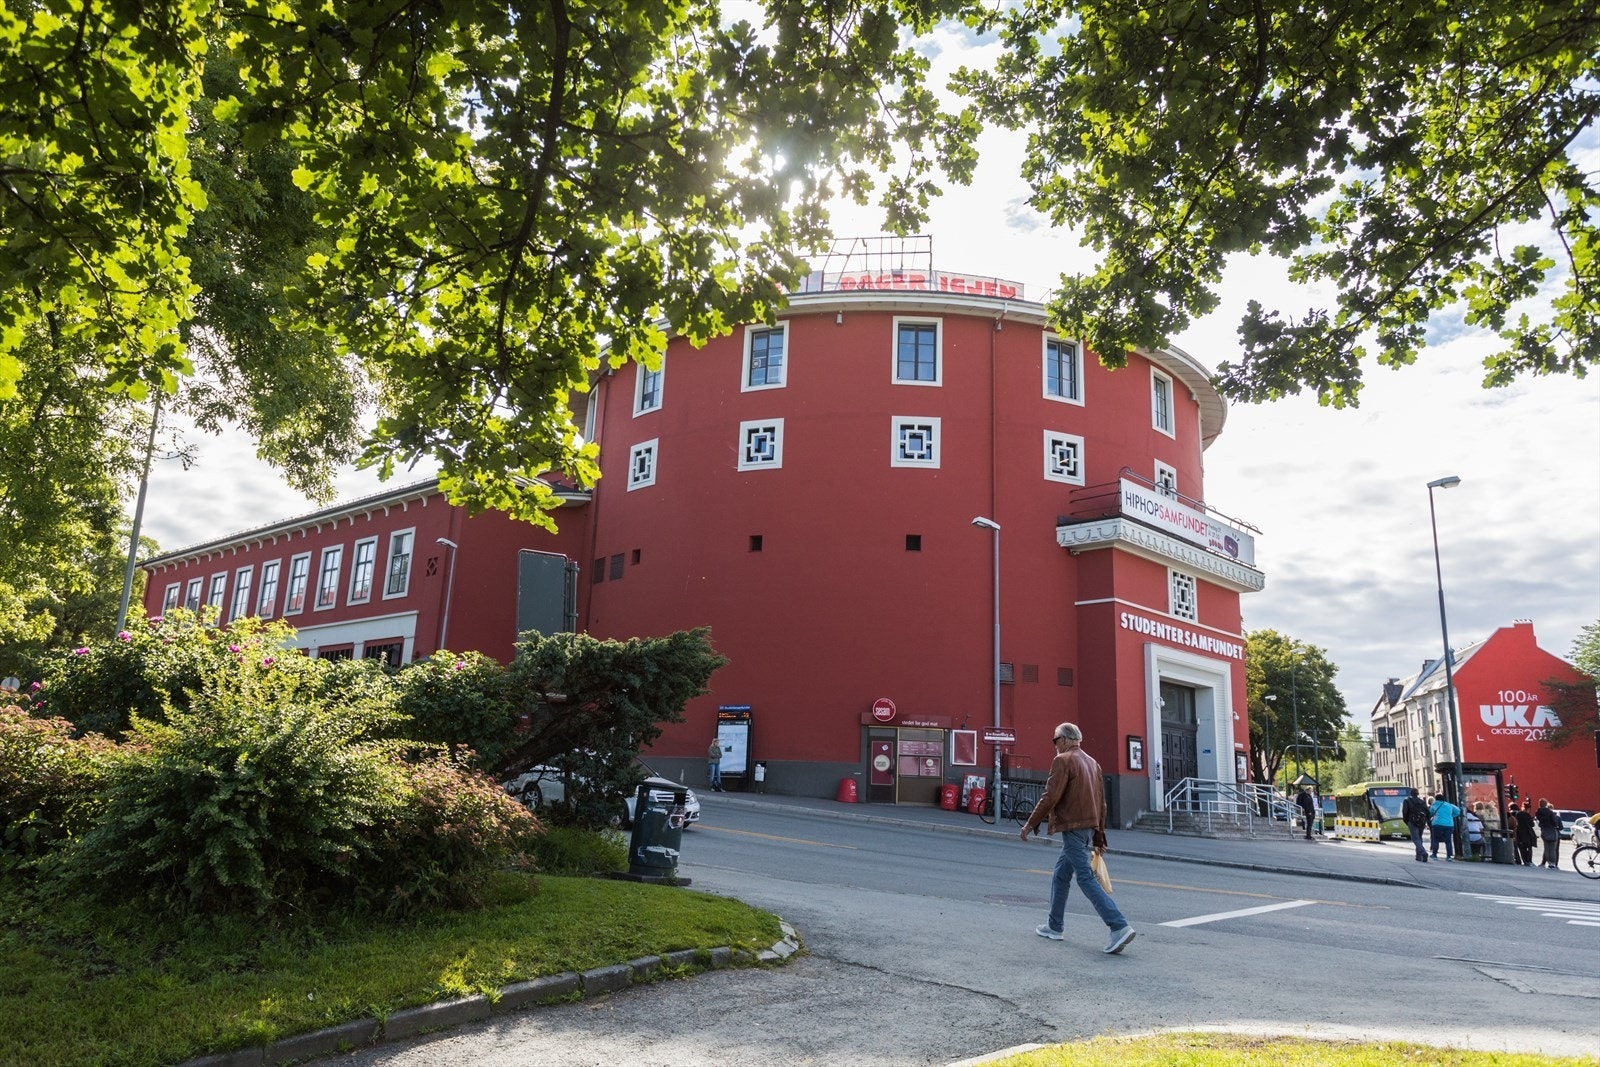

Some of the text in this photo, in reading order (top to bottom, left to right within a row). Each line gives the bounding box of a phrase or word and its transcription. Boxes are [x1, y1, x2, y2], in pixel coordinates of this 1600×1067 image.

[840, 273, 1016, 299] DAGER IGJEN
[1125, 490, 1208, 537] HIPHOPSAMFUNDET
[1120, 612, 1243, 660] STUDENTERSAMFUNDET
[1497, 690, 1538, 703] 100 ÅR
[1479, 705, 1563, 727] UKA
